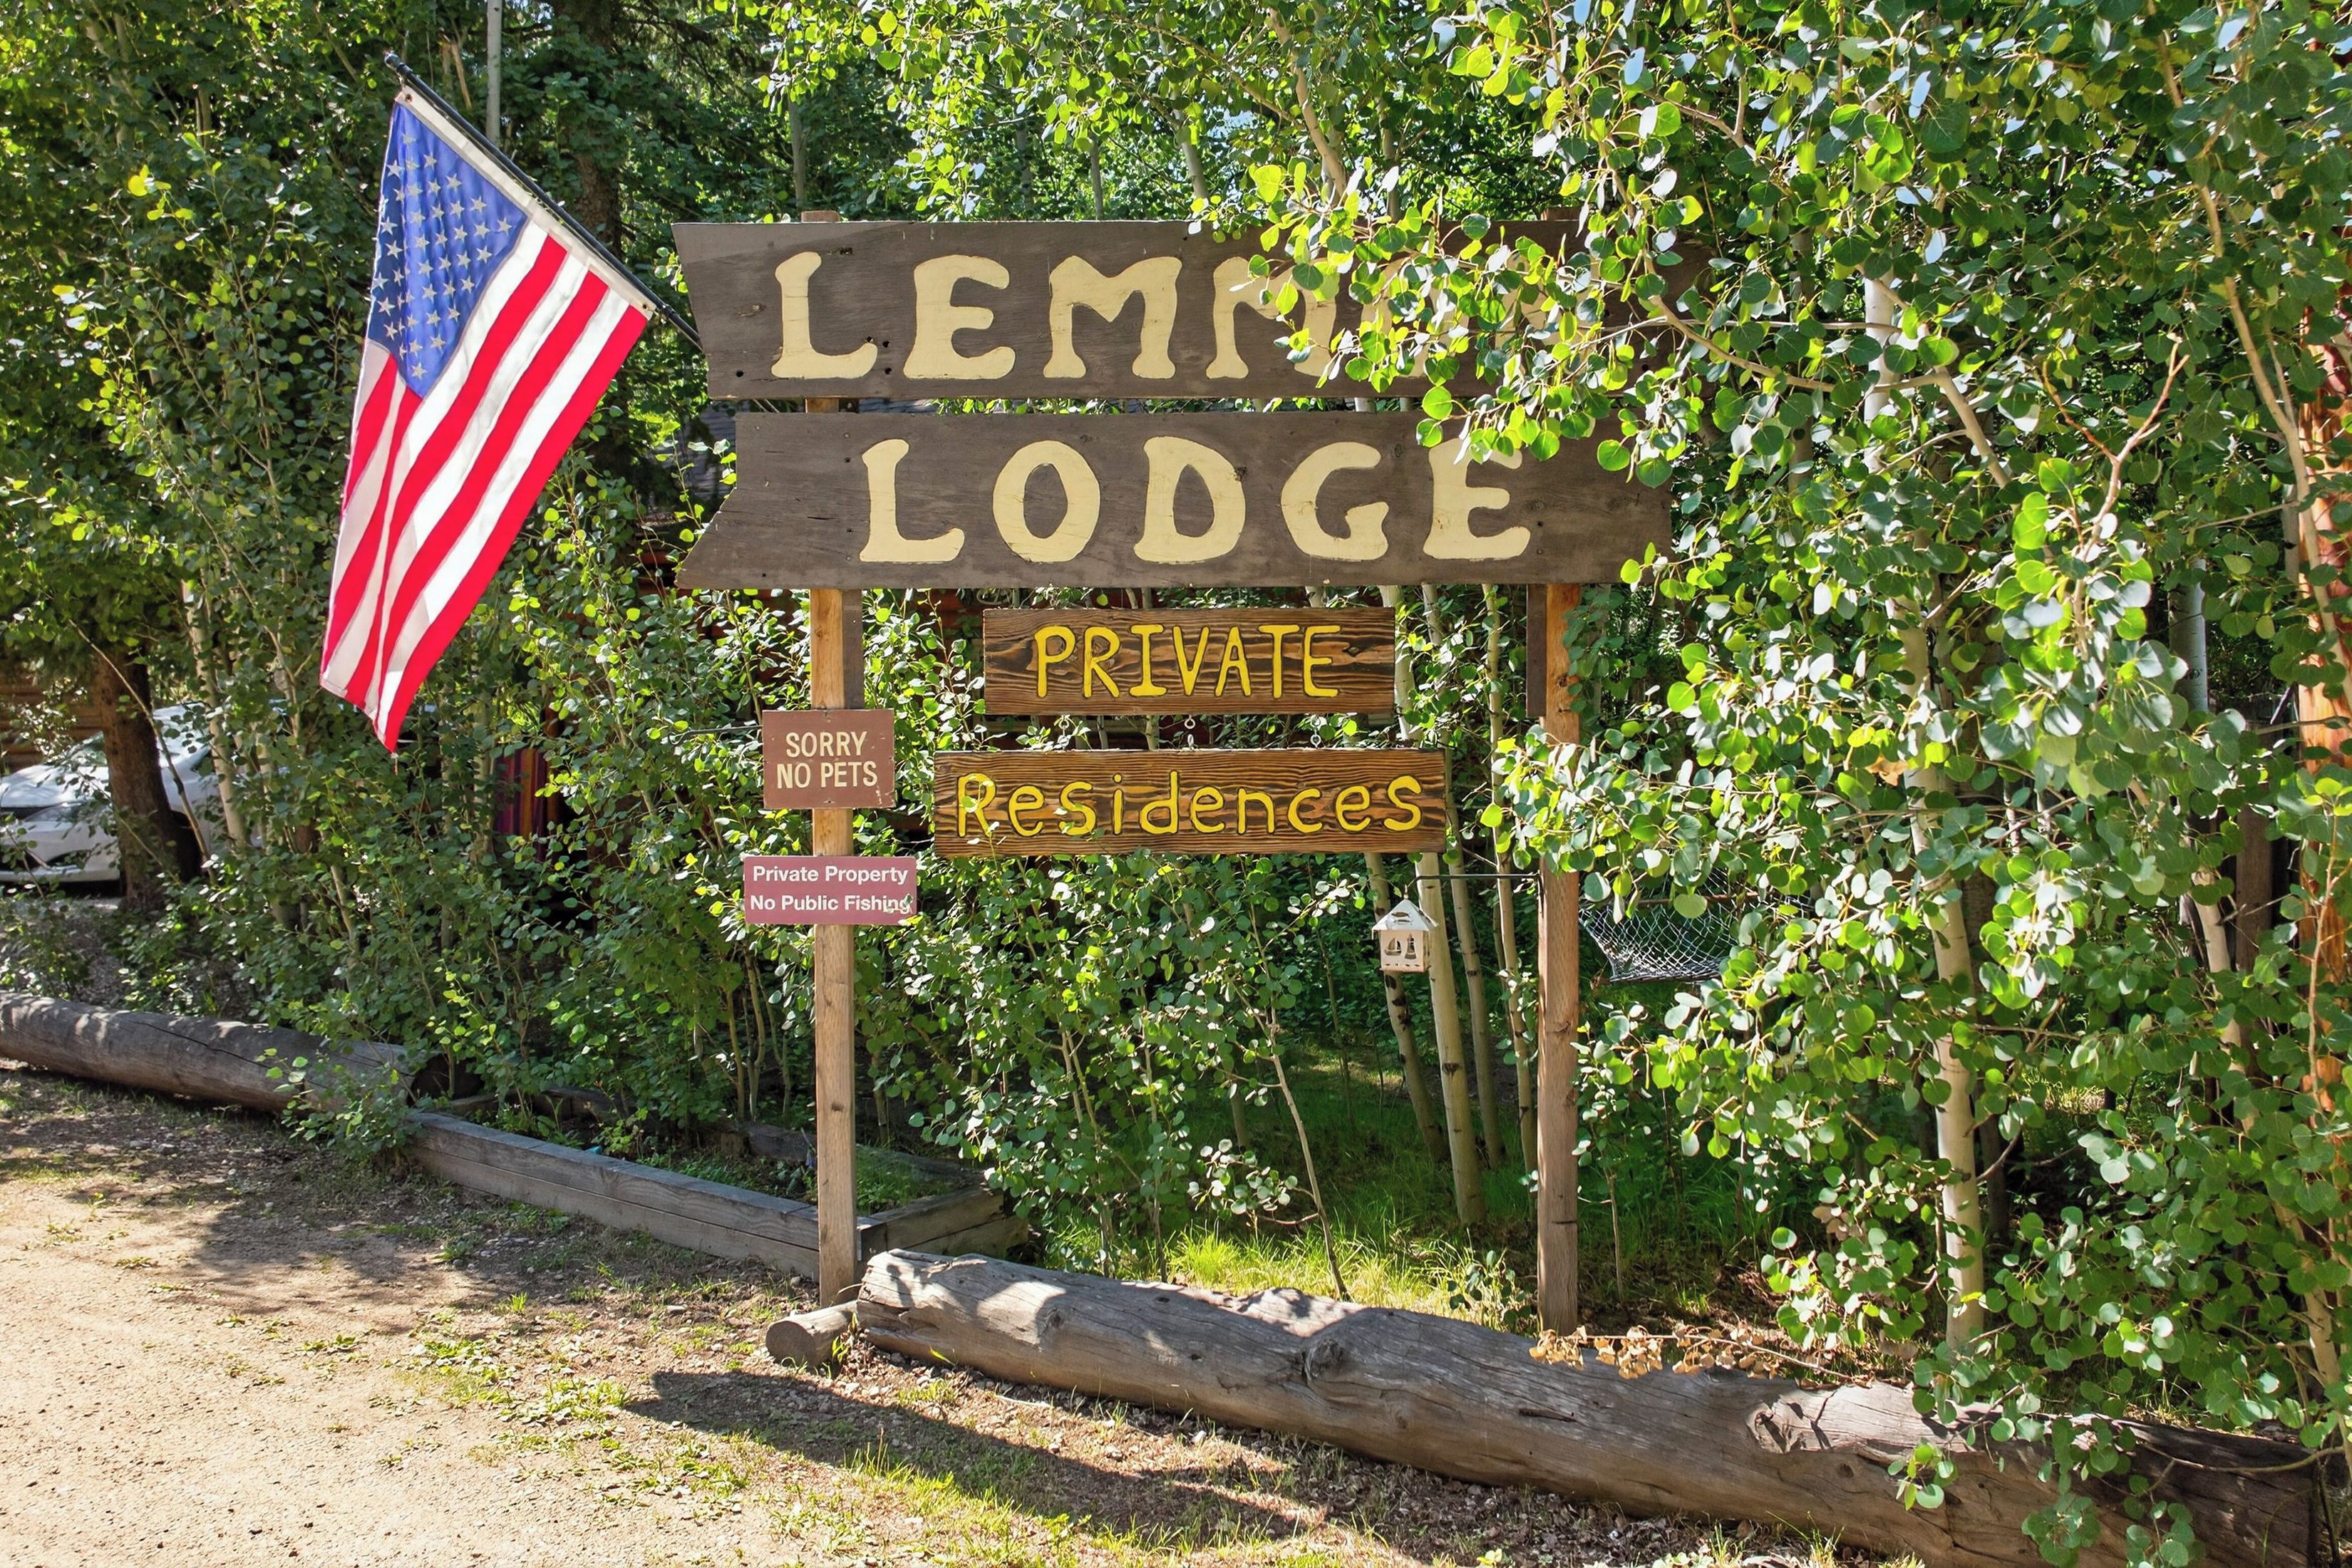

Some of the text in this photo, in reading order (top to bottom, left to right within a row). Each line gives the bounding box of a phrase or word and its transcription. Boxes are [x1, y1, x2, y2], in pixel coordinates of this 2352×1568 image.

[770, 251, 1604, 381] LEMM
[860, 438, 1532, 564] LODGE
[1033, 624, 1342, 699] PRIVATE
[785, 731, 867, 758] SORRY
[777, 760, 878, 789] NO PETS
[956, 770, 1423, 837] Residences
[753, 865, 908, 885] Private Property
[750, 894, 911, 914] No Public Fishing
